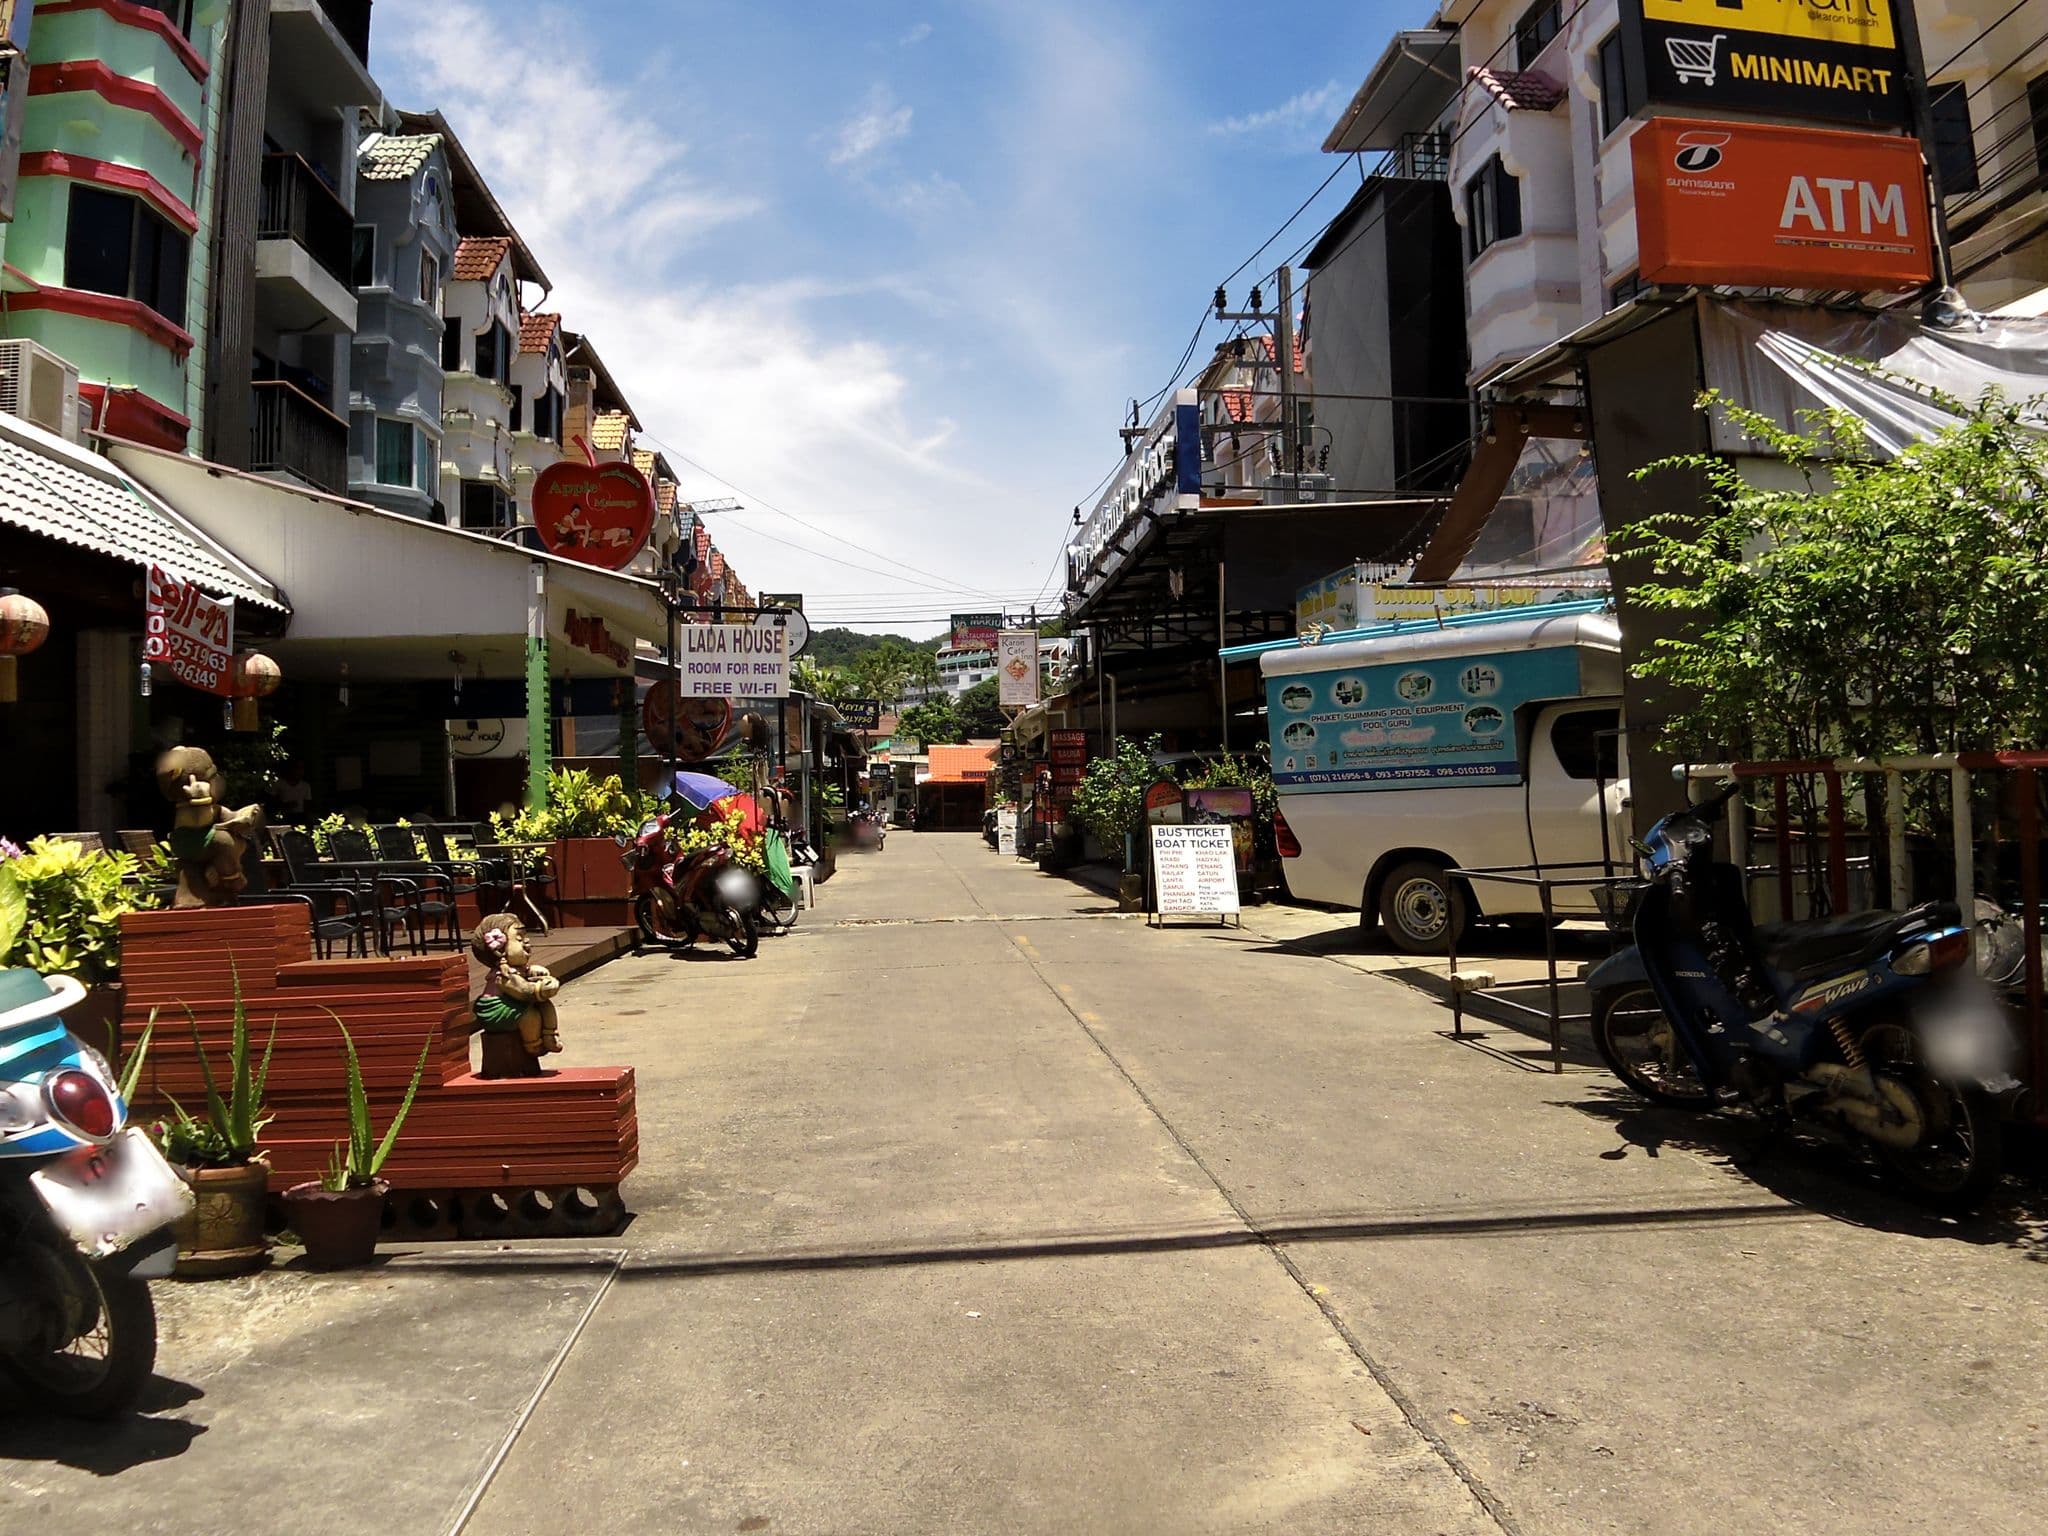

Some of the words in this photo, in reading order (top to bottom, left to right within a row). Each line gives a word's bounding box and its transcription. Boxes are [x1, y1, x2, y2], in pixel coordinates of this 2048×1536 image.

[1847, 14, 1880, 27] beach
[1730, 52, 1892, 95] MINIMART
[1779, 175, 1909, 237] ATM
[548, 480, 598, 496] Apple
[688, 628, 727, 653] LADA
[733, 629, 783, 654] HOUSE
[1001, 639, 1026, 648] Karon
[688, 662, 722, 675] ROOM
[727, 662, 749, 675] FOR
[753, 663, 783, 675] RENT
[693, 682, 733, 694] FREE
[740, 682, 777, 695] WI-FI
[1311, 713, 1341, 722] PHUKET
[1344, 710, 1388, 720] SWIMMING
[1390, 708, 1413, 716] POOL
[1415, 703, 1466, 715] EQUIPMENT
[1362, 721, 1384, 729] POOL
[1387, 720, 1411, 728] GURU
[1052, 732, 1086, 742] MASSAGE
[1286, 758, 1294, 769] 4
[1436, 766, 1497, 776] 098-0101220
[1157, 828, 1183, 837] BUS
[1186, 828, 1226, 837] TICKET
[1154, 839, 1187, 848] BOAT
[1190, 839, 1231, 848] TICKET
